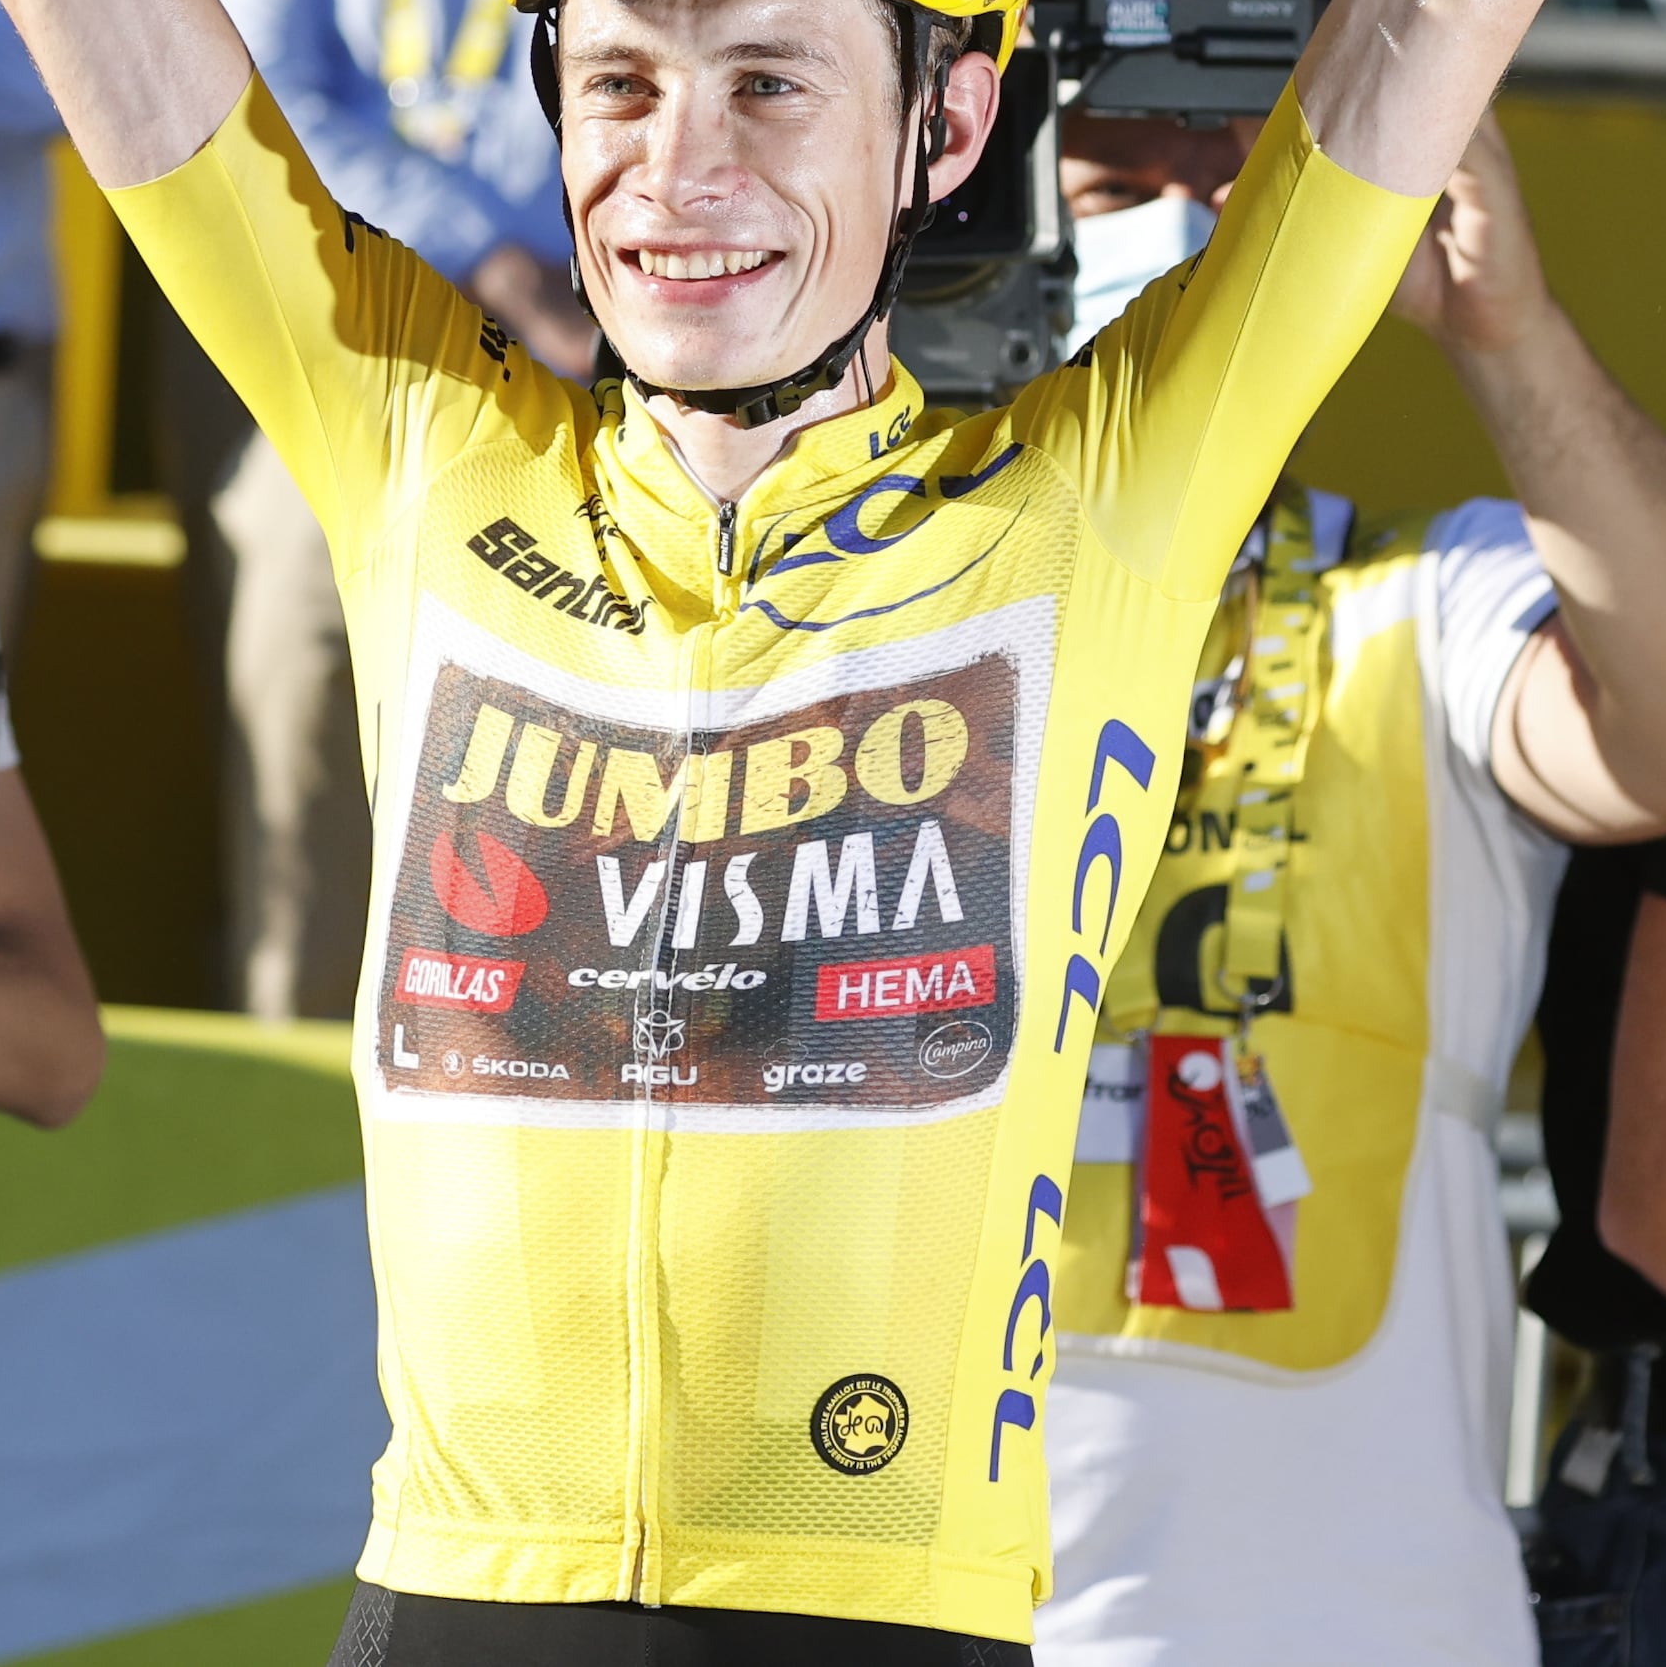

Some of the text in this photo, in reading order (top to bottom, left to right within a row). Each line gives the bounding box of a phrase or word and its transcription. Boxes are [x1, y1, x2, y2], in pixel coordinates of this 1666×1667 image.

[442, 698, 971, 844] JUMBO
[596, 819, 965, 950] VISMA
[1053, 718, 1157, 1055] LCL
[404, 958, 506, 1005] GORILLAS
[567, 961, 767, 993] cervélo
[836, 962, 978, 1012] HEMA
[924, 1031, 989, 1065] Campina
[471, 1054, 571, 1082] ŠKODA
[620, 1064, 700, 1088] AGU
[762, 1058, 868, 1095] graze
[987, 1172, 1064, 1483] LCL
[825, 1382, 855, 1412] MAILLOT
[855, 1380, 872, 1390] EST
[872, 1380, 882, 1392] LE
[855, 1460, 865, 1470] IS
[865, 1456, 884, 1469] THE
